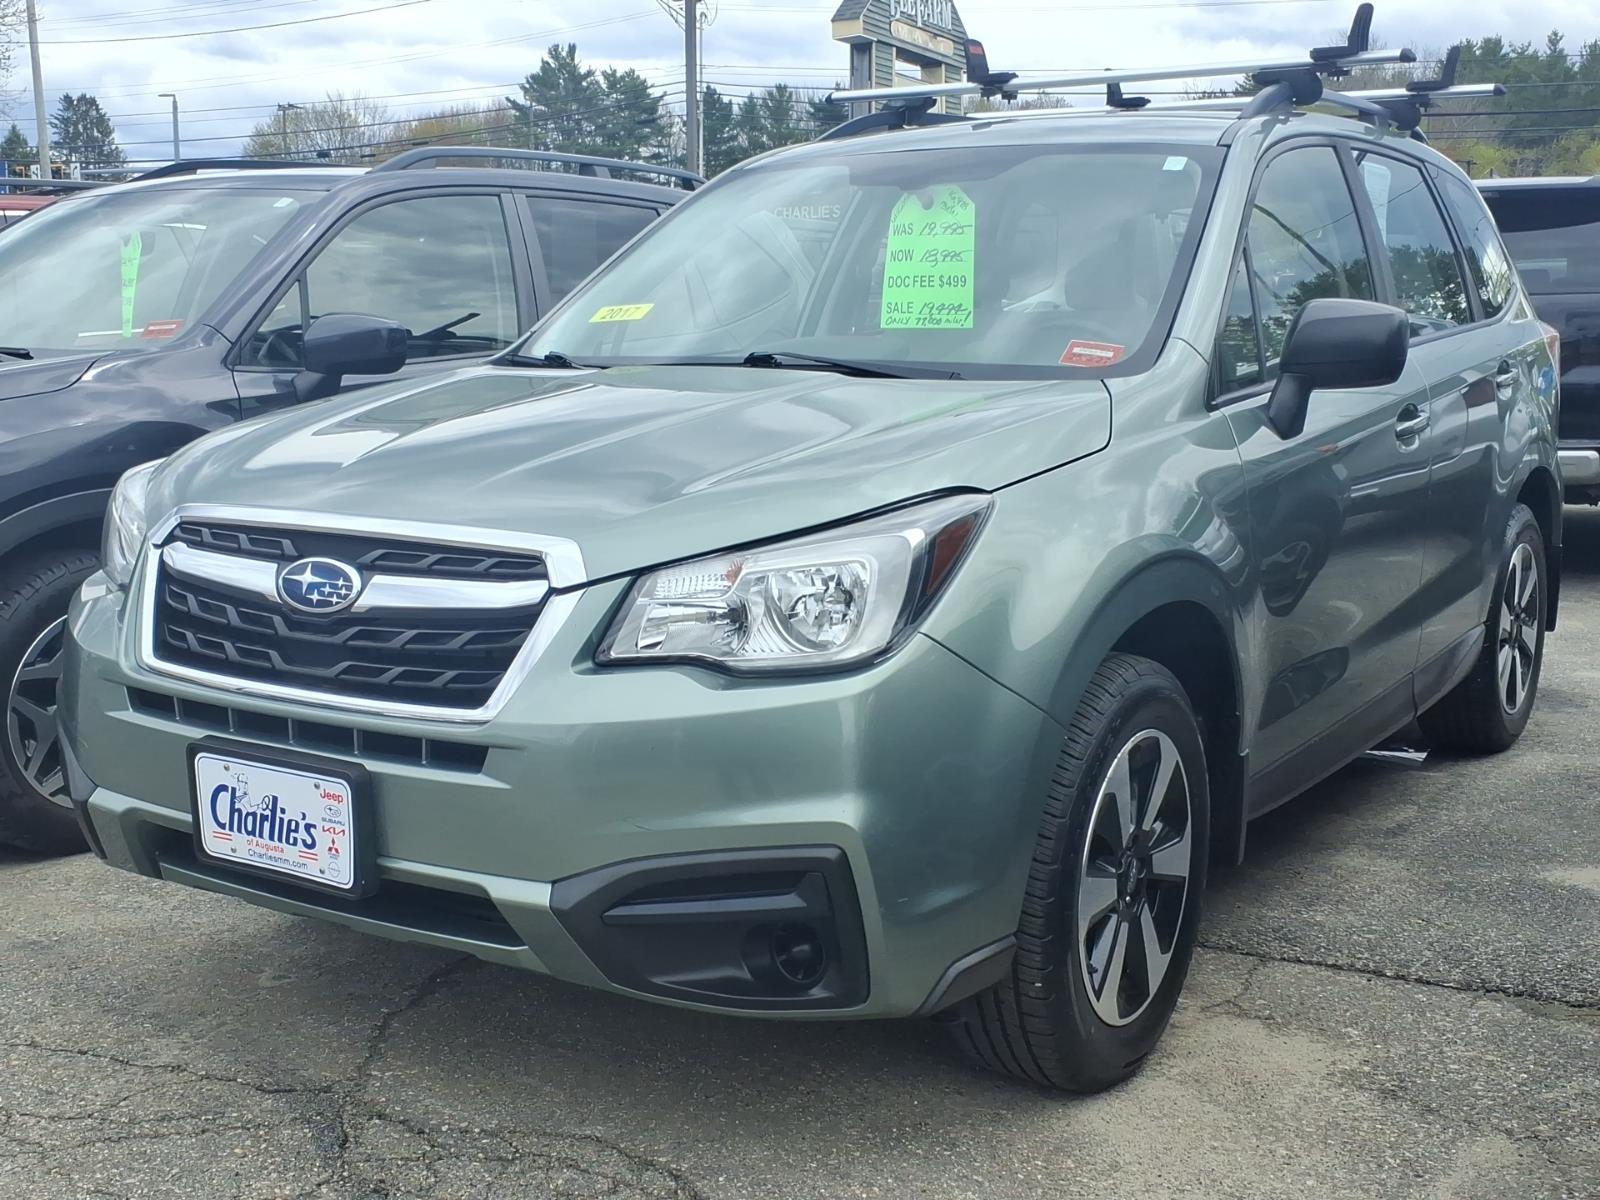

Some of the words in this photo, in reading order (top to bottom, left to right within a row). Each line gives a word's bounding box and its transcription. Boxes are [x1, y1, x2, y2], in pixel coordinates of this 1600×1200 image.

[774, 204, 841, 219] CHARLIE'S
[892, 222, 914, 237] WAS
[890, 248, 915, 263] NOW
[887, 275, 910, 289] DOC
[912, 274, 935, 288] FEE
[938, 274, 967, 289] $499
[599, 306, 642, 320] 2017
[886, 301, 914, 314] SALE
[885, 316, 911, 326] ONLY
[320, 788, 344, 805] Jeep
[210, 784, 317, 850] Charlie's
[255, 840, 285, 854] Augusta
[247, 848, 308, 870] Charliesmm.com
